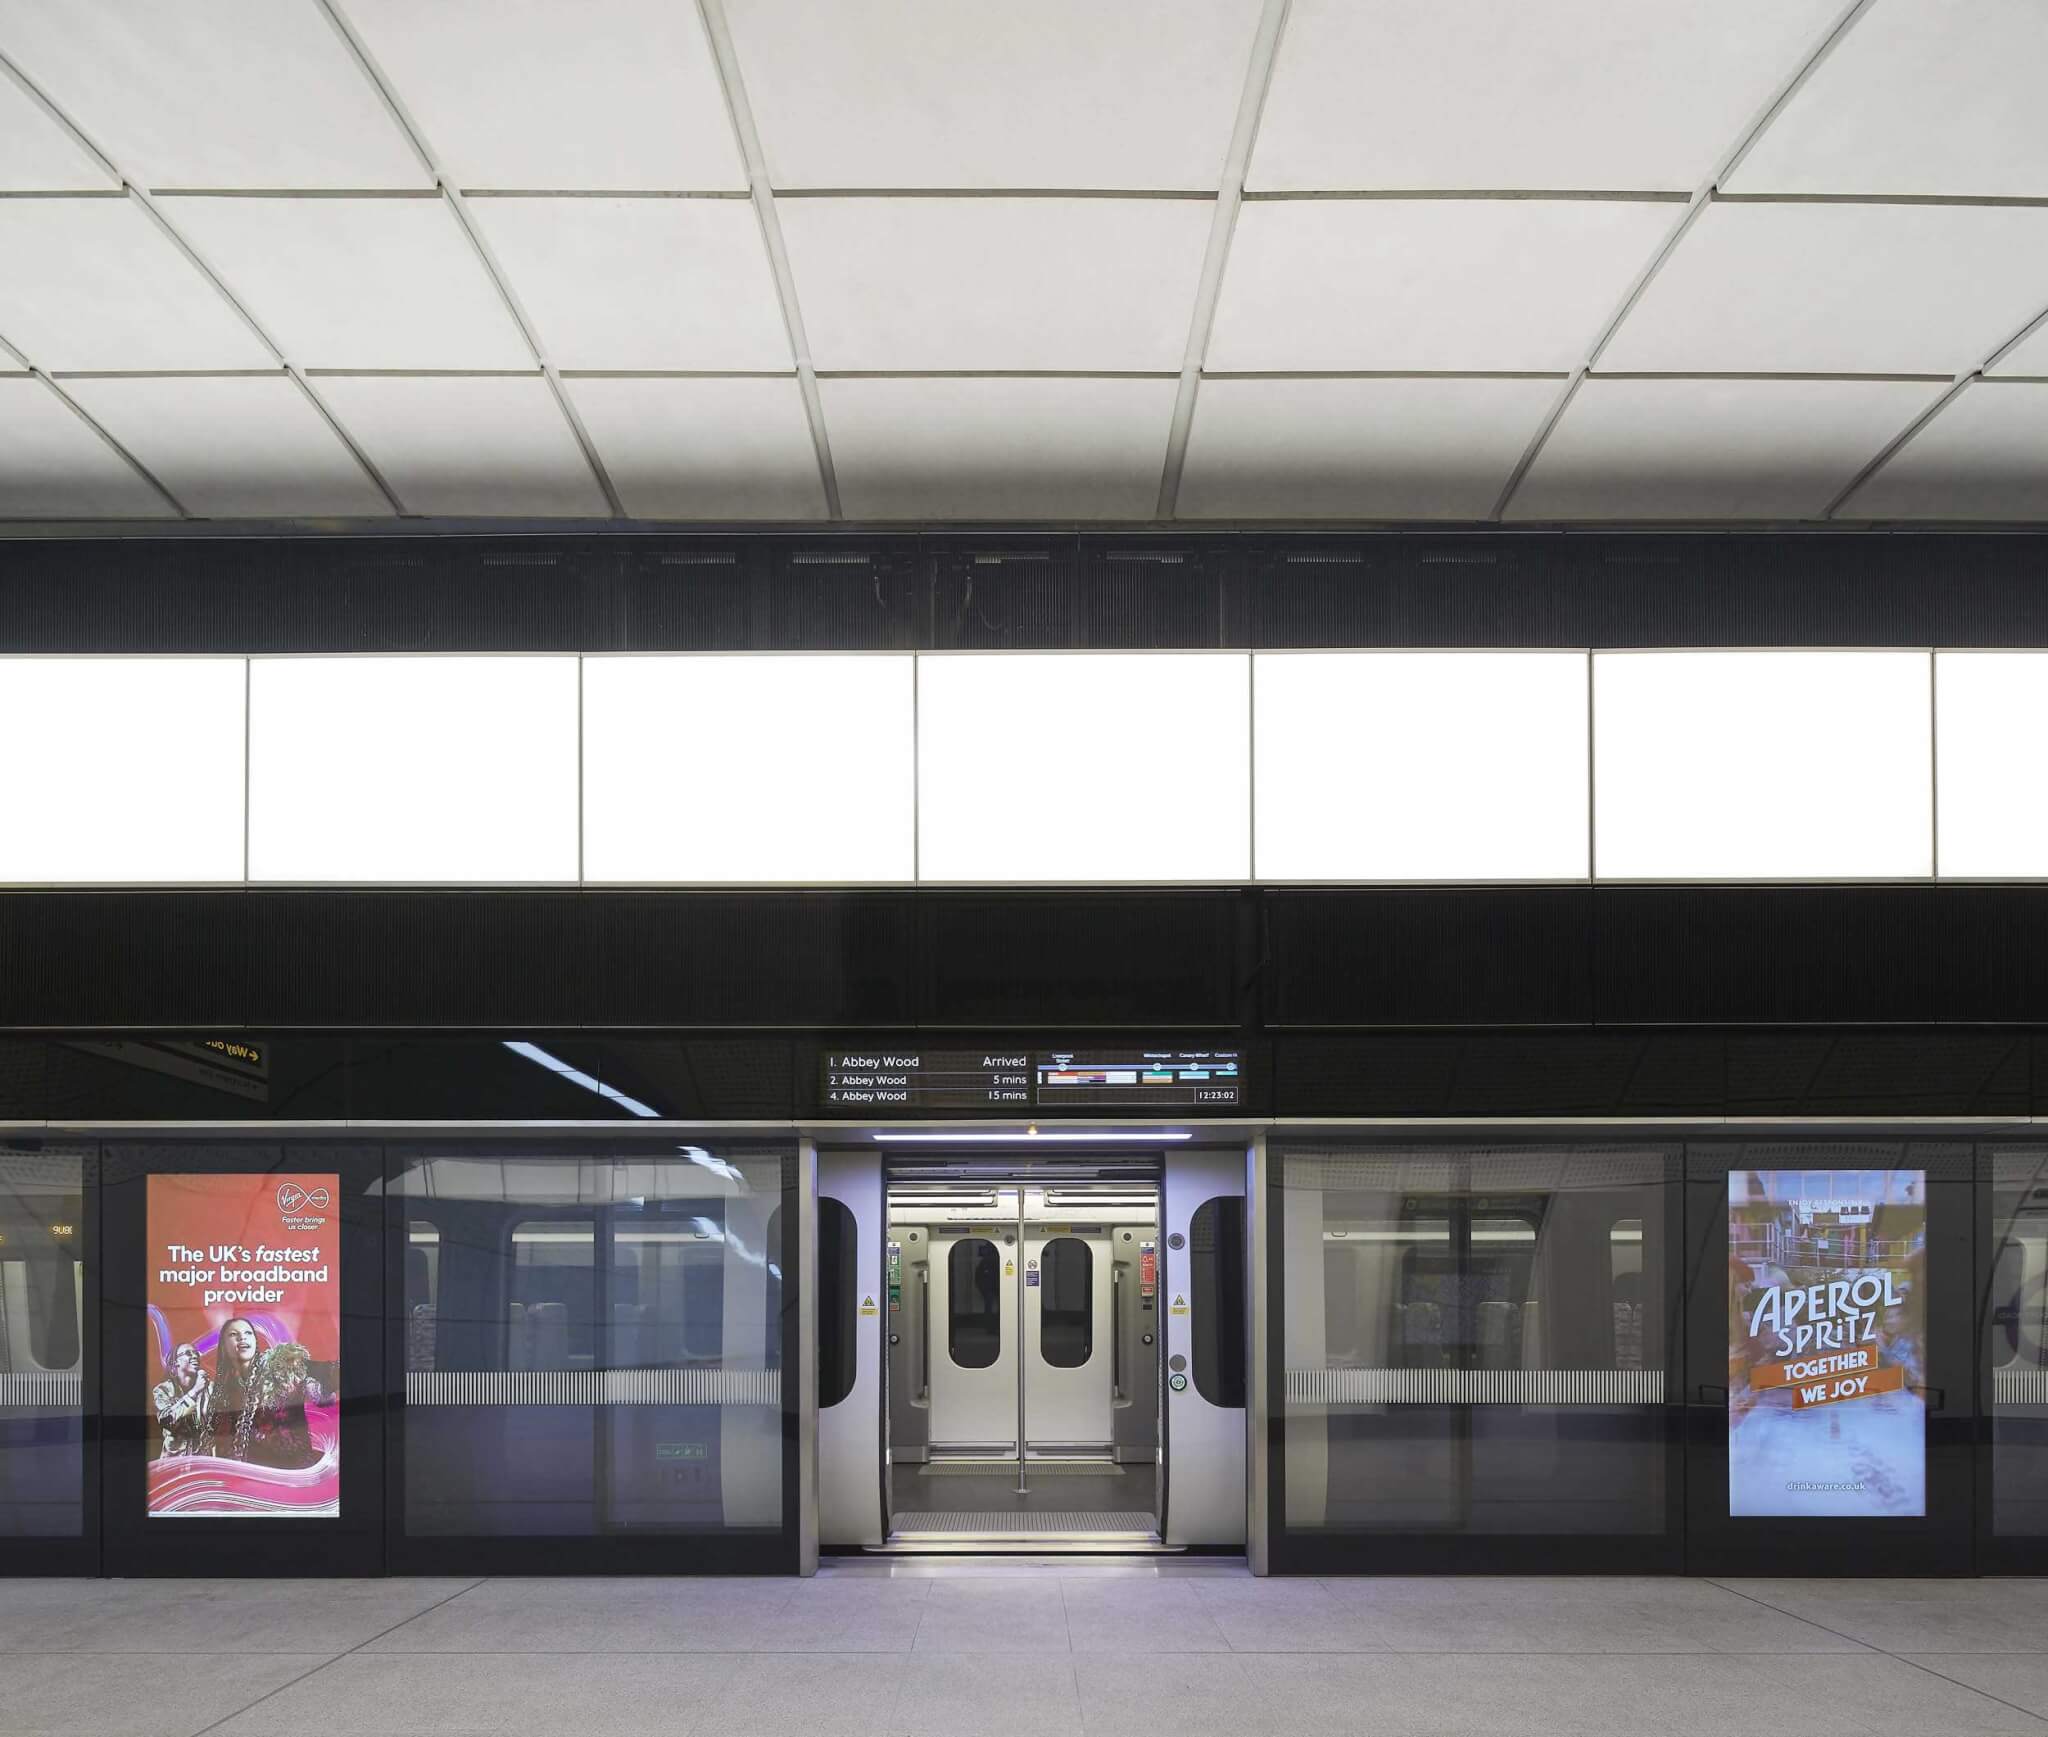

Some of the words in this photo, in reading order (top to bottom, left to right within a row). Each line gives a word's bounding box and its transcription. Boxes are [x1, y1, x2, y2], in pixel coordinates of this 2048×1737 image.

[842, 1056, 880, 1069] Abbey
[883, 1056, 919, 1067] Wood
[983, 1056, 1026, 1067] Arrived
[830, 1076, 838, 1085] 2.
[842, 1075, 874, 1087] Abbey
[876, 1075, 907, 1085] Wood
[993, 1075, 1000, 1084] 5
[1002, 1075, 1027, 1084] mins
[830, 1092, 839, 1101] 4.
[842, 1091, 874, 1103] Abbey
[876, 1091, 907, 1101] Wood
[988, 1091, 1000, 1100] 15
[1002, 1091, 1027, 1100] mins
[1199, 1091, 1234, 1099] 12:23:02
[281, 1188, 303, 1208] Virgin
[168, 1245, 204, 1263] The
[209, 1245, 251, 1263] UK’s
[255, 1245, 320, 1263] fastest
[159, 1265, 216, 1286] major
[220, 1265, 328, 1283] broadband
[204, 1285, 284, 1306] provider
[1750, 1272, 1902, 1337] APEROL
[1784, 1350, 1868, 1381] TOGETHER
[1801, 1384, 1826, 1404] WE
[1830, 1376, 1869, 1398] JOY
[1787, 1481, 1866, 1491] drinkaware.co.uk
